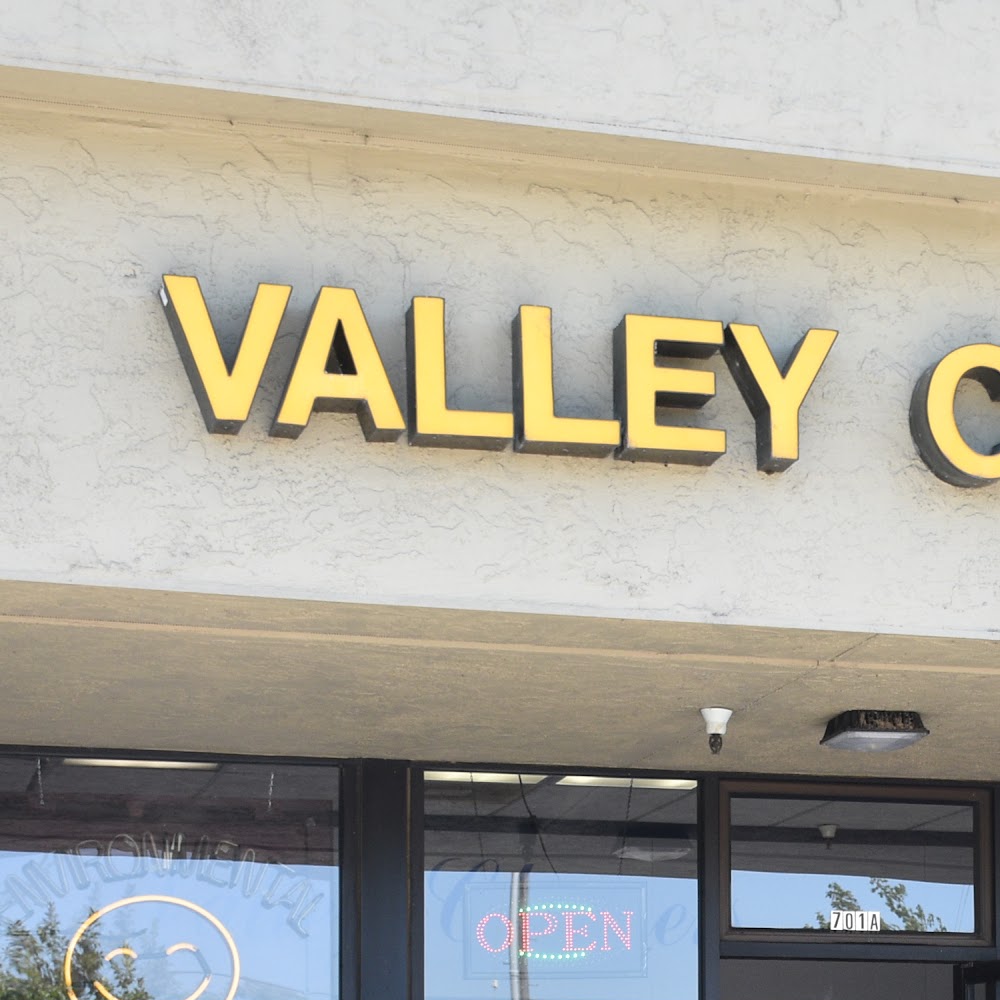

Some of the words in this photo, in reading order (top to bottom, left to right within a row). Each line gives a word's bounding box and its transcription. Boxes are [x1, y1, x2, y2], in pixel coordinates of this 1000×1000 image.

[161, 274, 838, 470] VALLEY
[476, 911, 634, 953] OPEN
[832, 911, 879, 931] 701A
